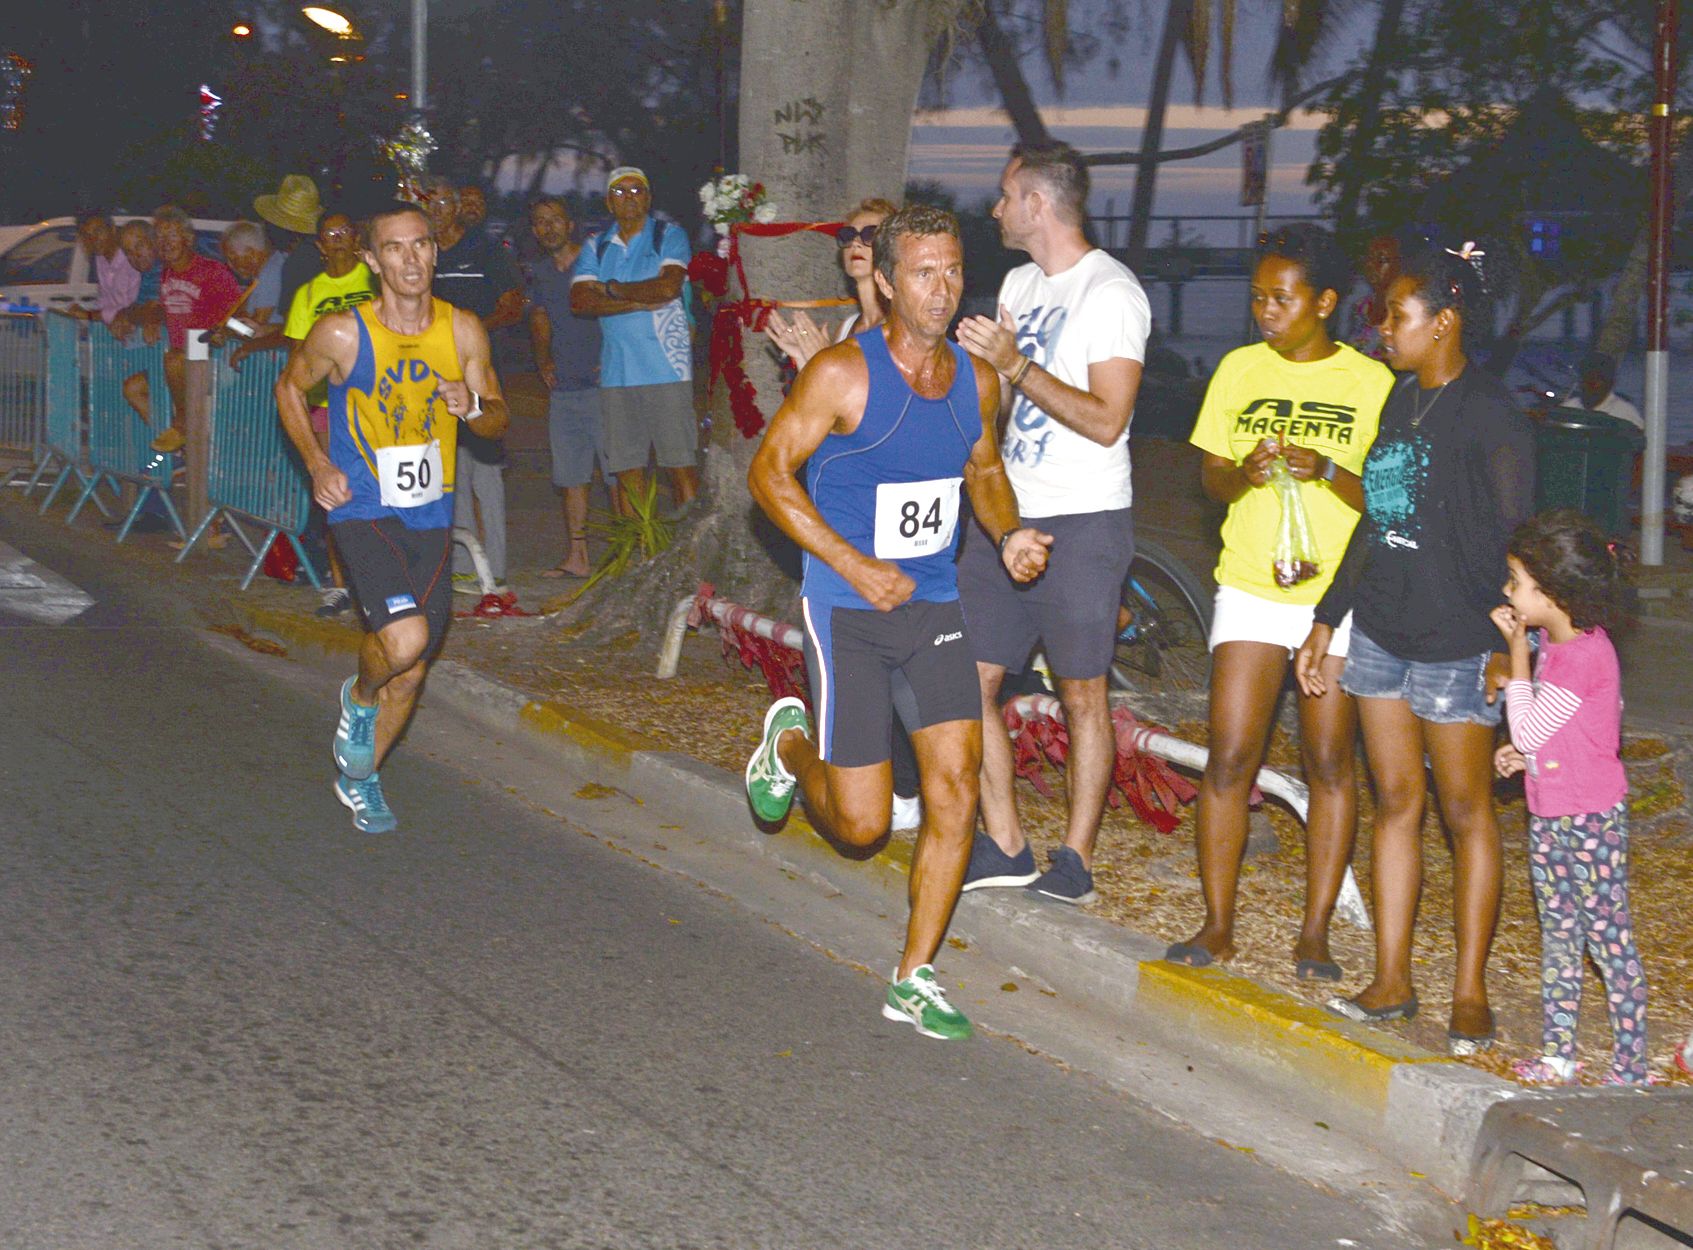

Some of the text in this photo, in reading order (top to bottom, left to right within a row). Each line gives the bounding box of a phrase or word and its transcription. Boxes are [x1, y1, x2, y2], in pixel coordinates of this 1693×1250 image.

[1241, 397, 1357, 424] AS
[1234, 416, 1354, 445] MAGENTA
[396, 457, 432, 492] 50
[899, 496, 943, 539] 84
